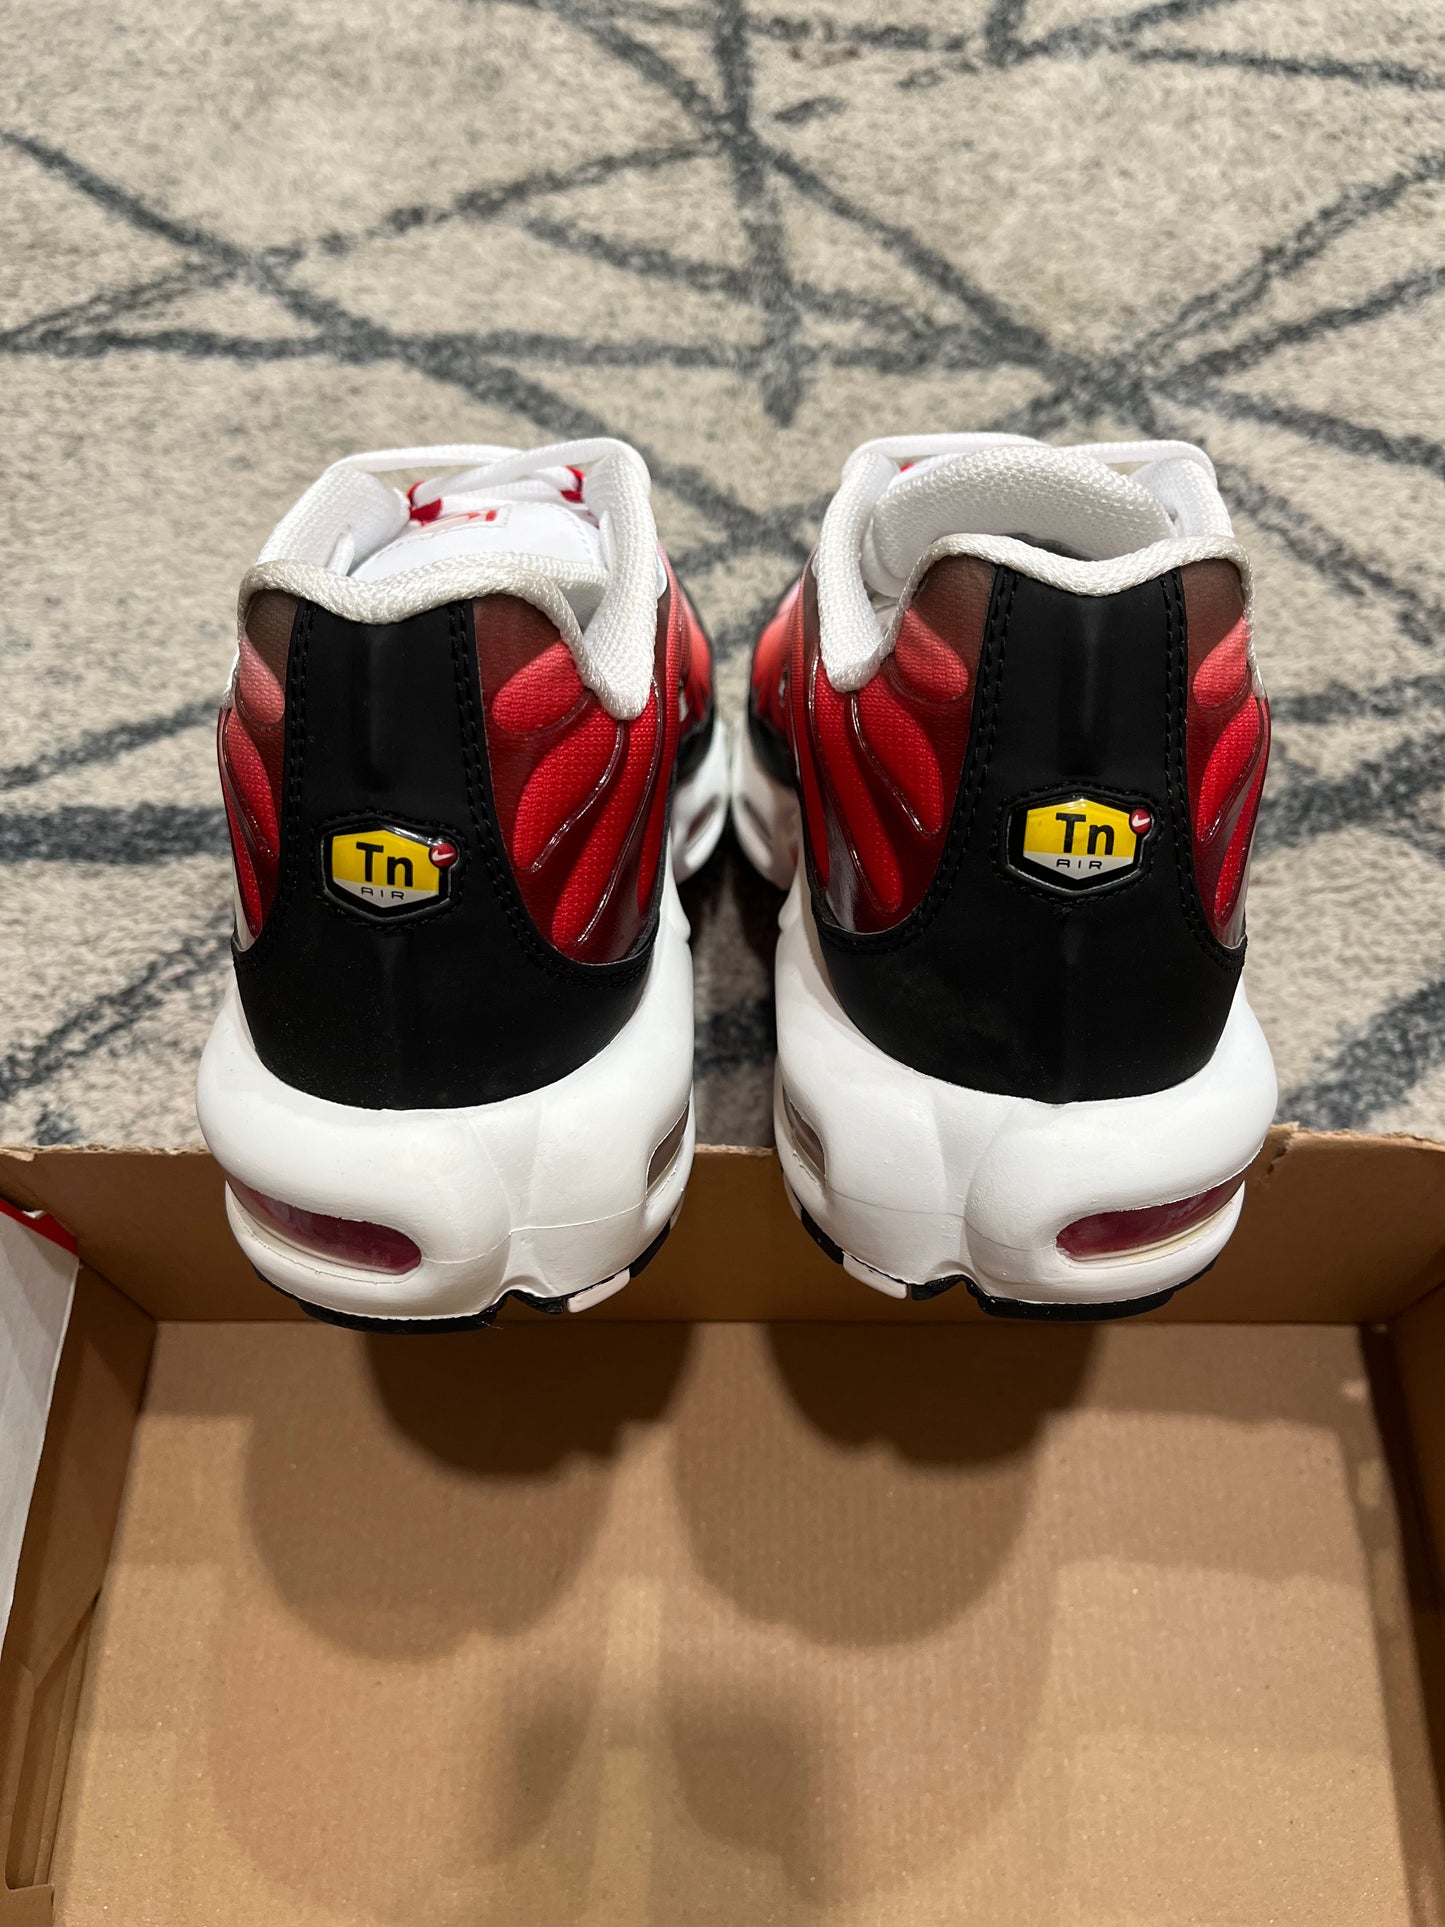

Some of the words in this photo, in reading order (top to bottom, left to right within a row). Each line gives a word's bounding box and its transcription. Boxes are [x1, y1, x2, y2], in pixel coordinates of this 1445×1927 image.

[1055, 812, 1115, 855] Tn
[356, 841, 413, 887] Tn
[1056, 858, 1103, 870] AIR
[361, 887, 405, 900] AIR
